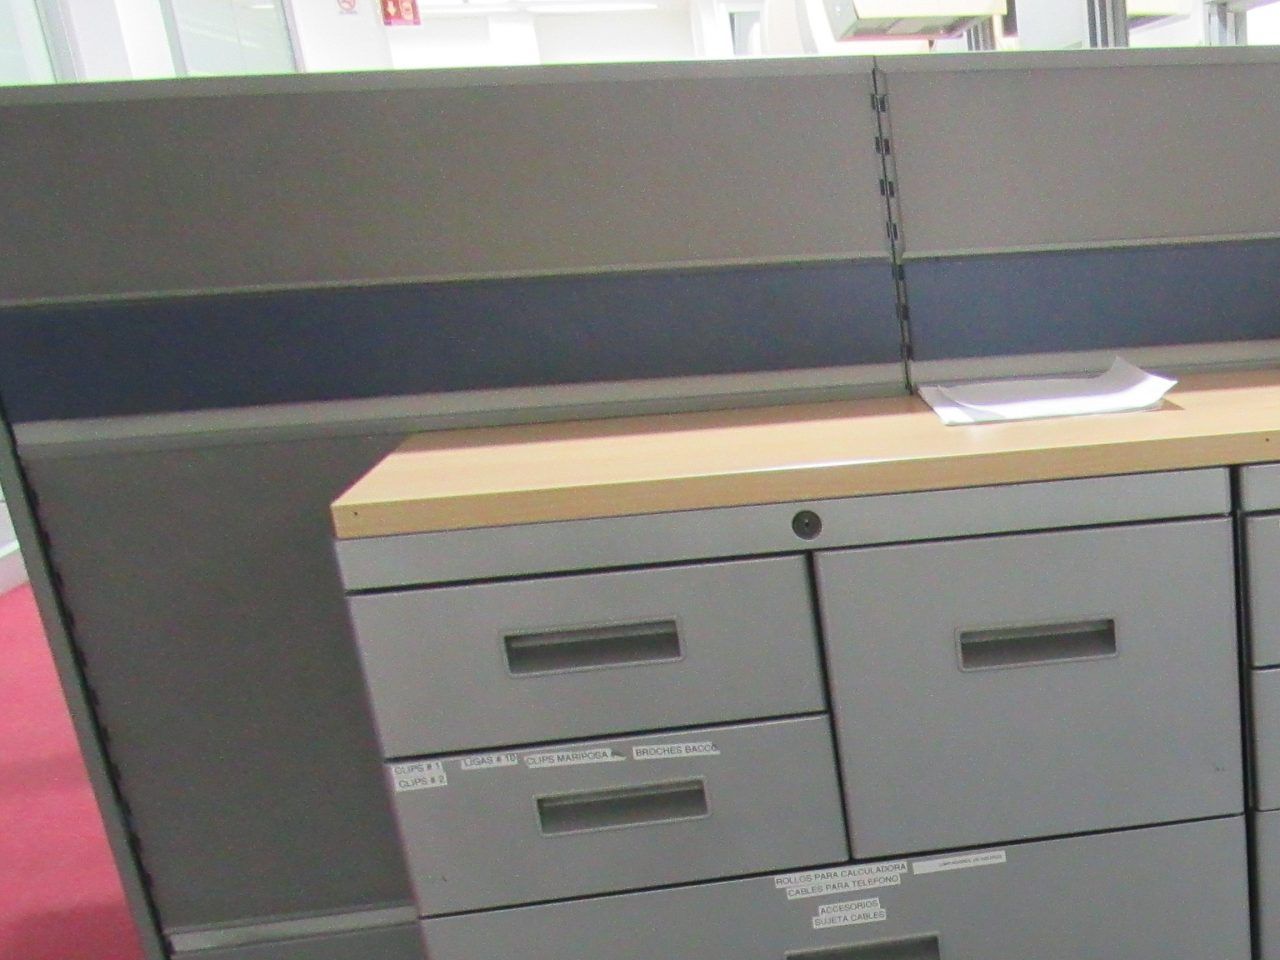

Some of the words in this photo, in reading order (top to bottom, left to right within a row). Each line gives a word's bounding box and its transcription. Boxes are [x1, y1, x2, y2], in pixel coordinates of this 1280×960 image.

[527, 755, 555, 766] CLIPS
[557, 751, 609, 762] MARIPOSA
[636, 747, 682, 757] BROCHES
[394, 763, 424, 775] CLIPS
[398, 778, 428, 788] CLIPS
[775, 874, 812, 885] ROLLOS
[814, 870, 839, 880] PARA
[840, 863, 907, 878] CALCULADORA
[788, 886, 824, 897] CABLES
[825, 881, 850, 892] PARA
[852, 874, 899, 888] TELEFONO
[820, 900, 878, 913] ACCESORIOS
[814, 914, 848, 926] SUJETA
[850, 910, 886, 921] CABLES
